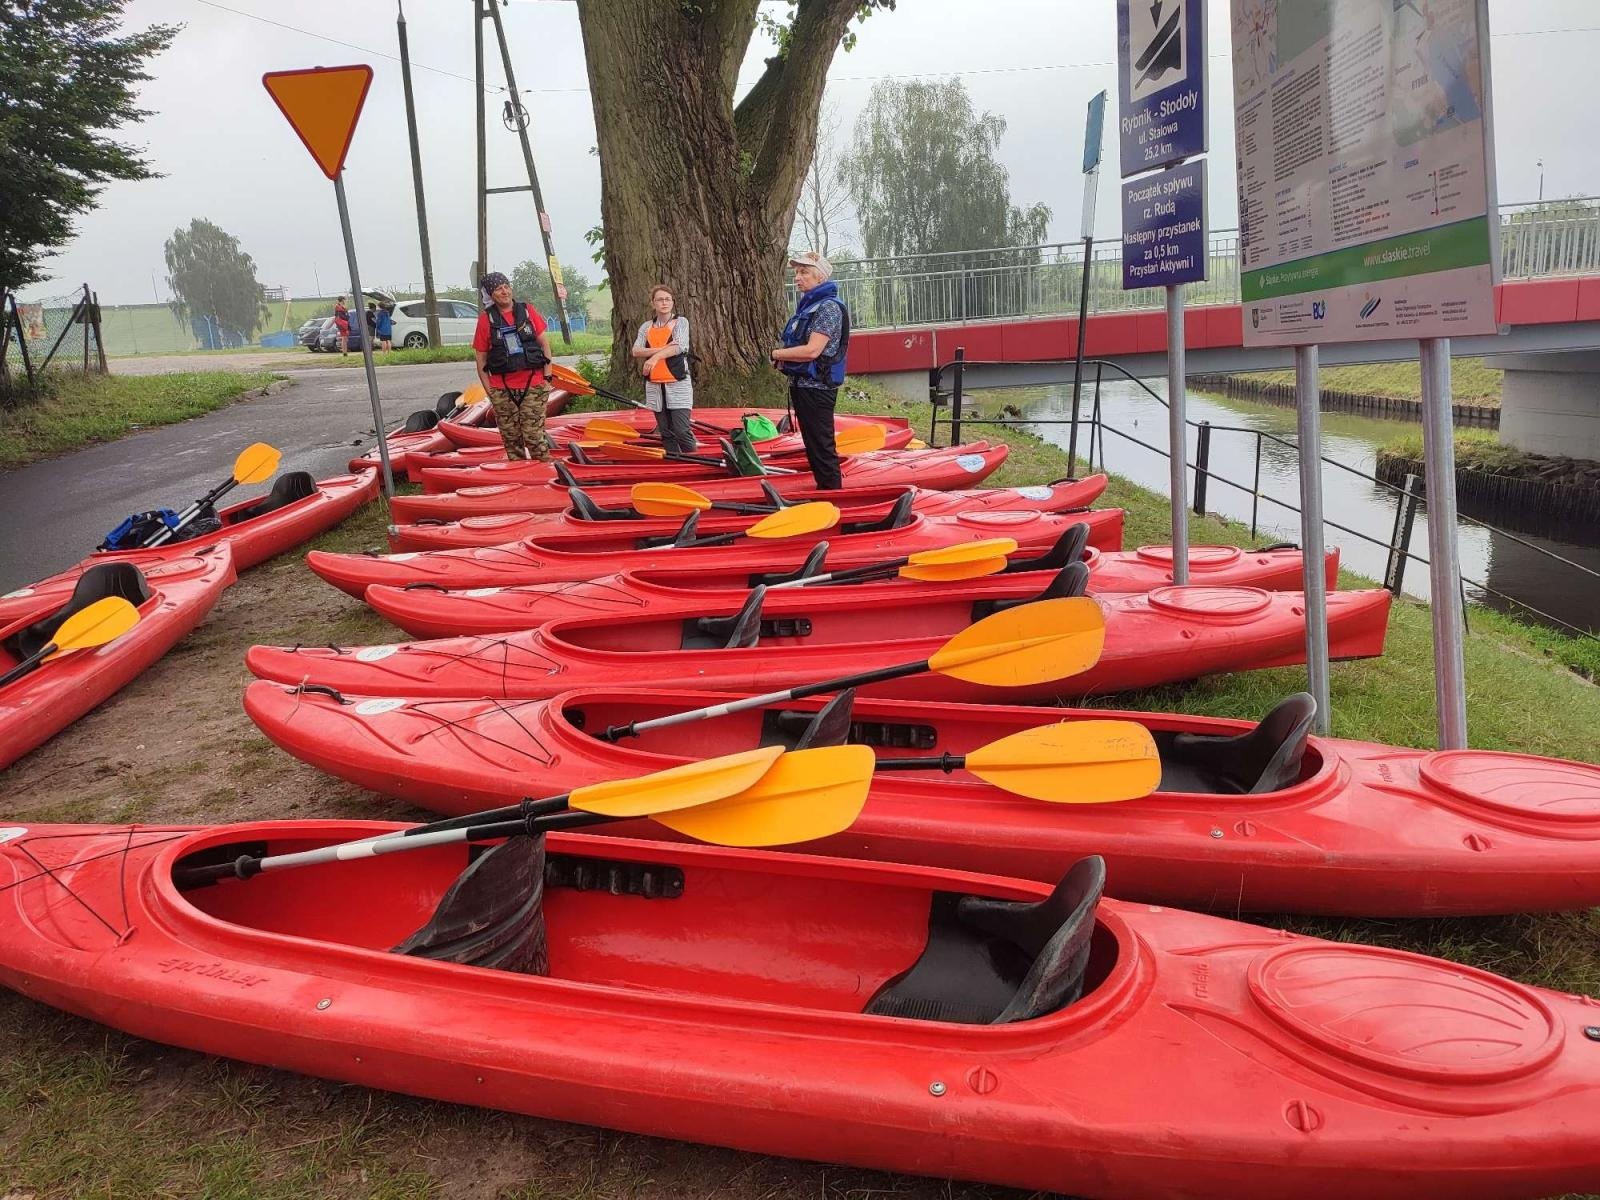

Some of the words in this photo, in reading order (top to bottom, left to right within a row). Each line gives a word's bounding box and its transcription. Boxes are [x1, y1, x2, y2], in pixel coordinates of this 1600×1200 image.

[1121, 107, 1152, 135] Rybnik
[1138, 130, 1148, 145] ul.
[1149, 121, 1178, 141] Stalowa
[1144, 144, 1160, 161] 25,2
[1160, 142, 1173, 155] km
[1128, 182, 1162, 204] Początek
[1163, 175, 1193, 196] spływu
[1143, 207, 1153, 219] rz.
[1154, 200, 1176, 216] Rudą
[1123, 229, 1157, 245] Następny
[1157, 217, 1201, 242] przystanek
[1144, 249, 1153, 260] za
[1153, 244, 1166, 260] 0,5
[1166, 243, 1179, 256] km
[1363, 239, 1431, 267] www.slaskie.travel
[1129, 260, 1159, 278] Przystań
[1159, 256, 1190, 274] Aktywni
